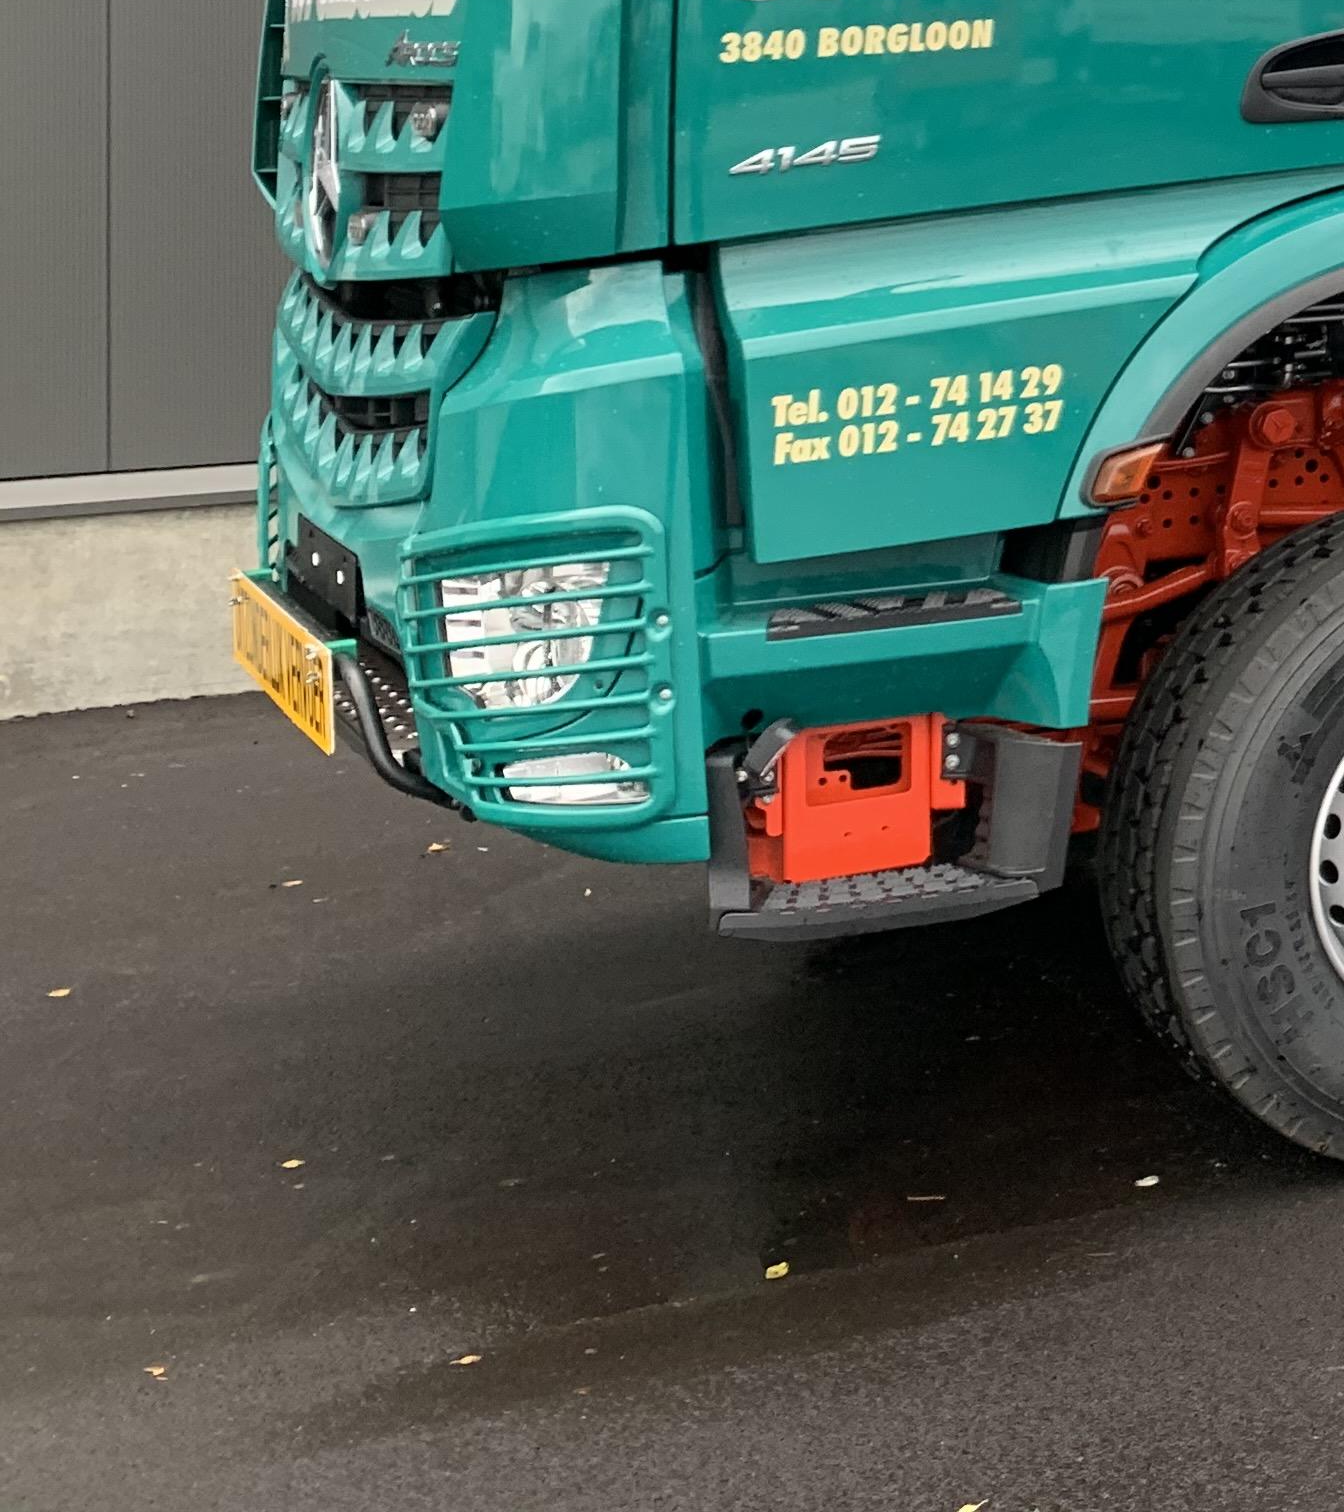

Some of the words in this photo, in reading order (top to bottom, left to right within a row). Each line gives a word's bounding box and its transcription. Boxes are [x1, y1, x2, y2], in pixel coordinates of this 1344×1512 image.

[719, 29, 806, 63] 3840
[817, 19, 994, 57] BORGLOON
[729, 135, 882, 176] 4145
[771, 389, 829, 428] Tel.
[836, 383, 898, 422] 012
[930, 375, 969, 410] 74
[979, 369, 1013, 404] 14
[1020, 363, 1064, 398] 29
[773, 431, 830, 466] Fax
[838, 420, 899, 458] 012
[931, 411, 970, 447] 74
[976, 406, 1018, 441] 27
[1023, 400, 1064, 435] 37
